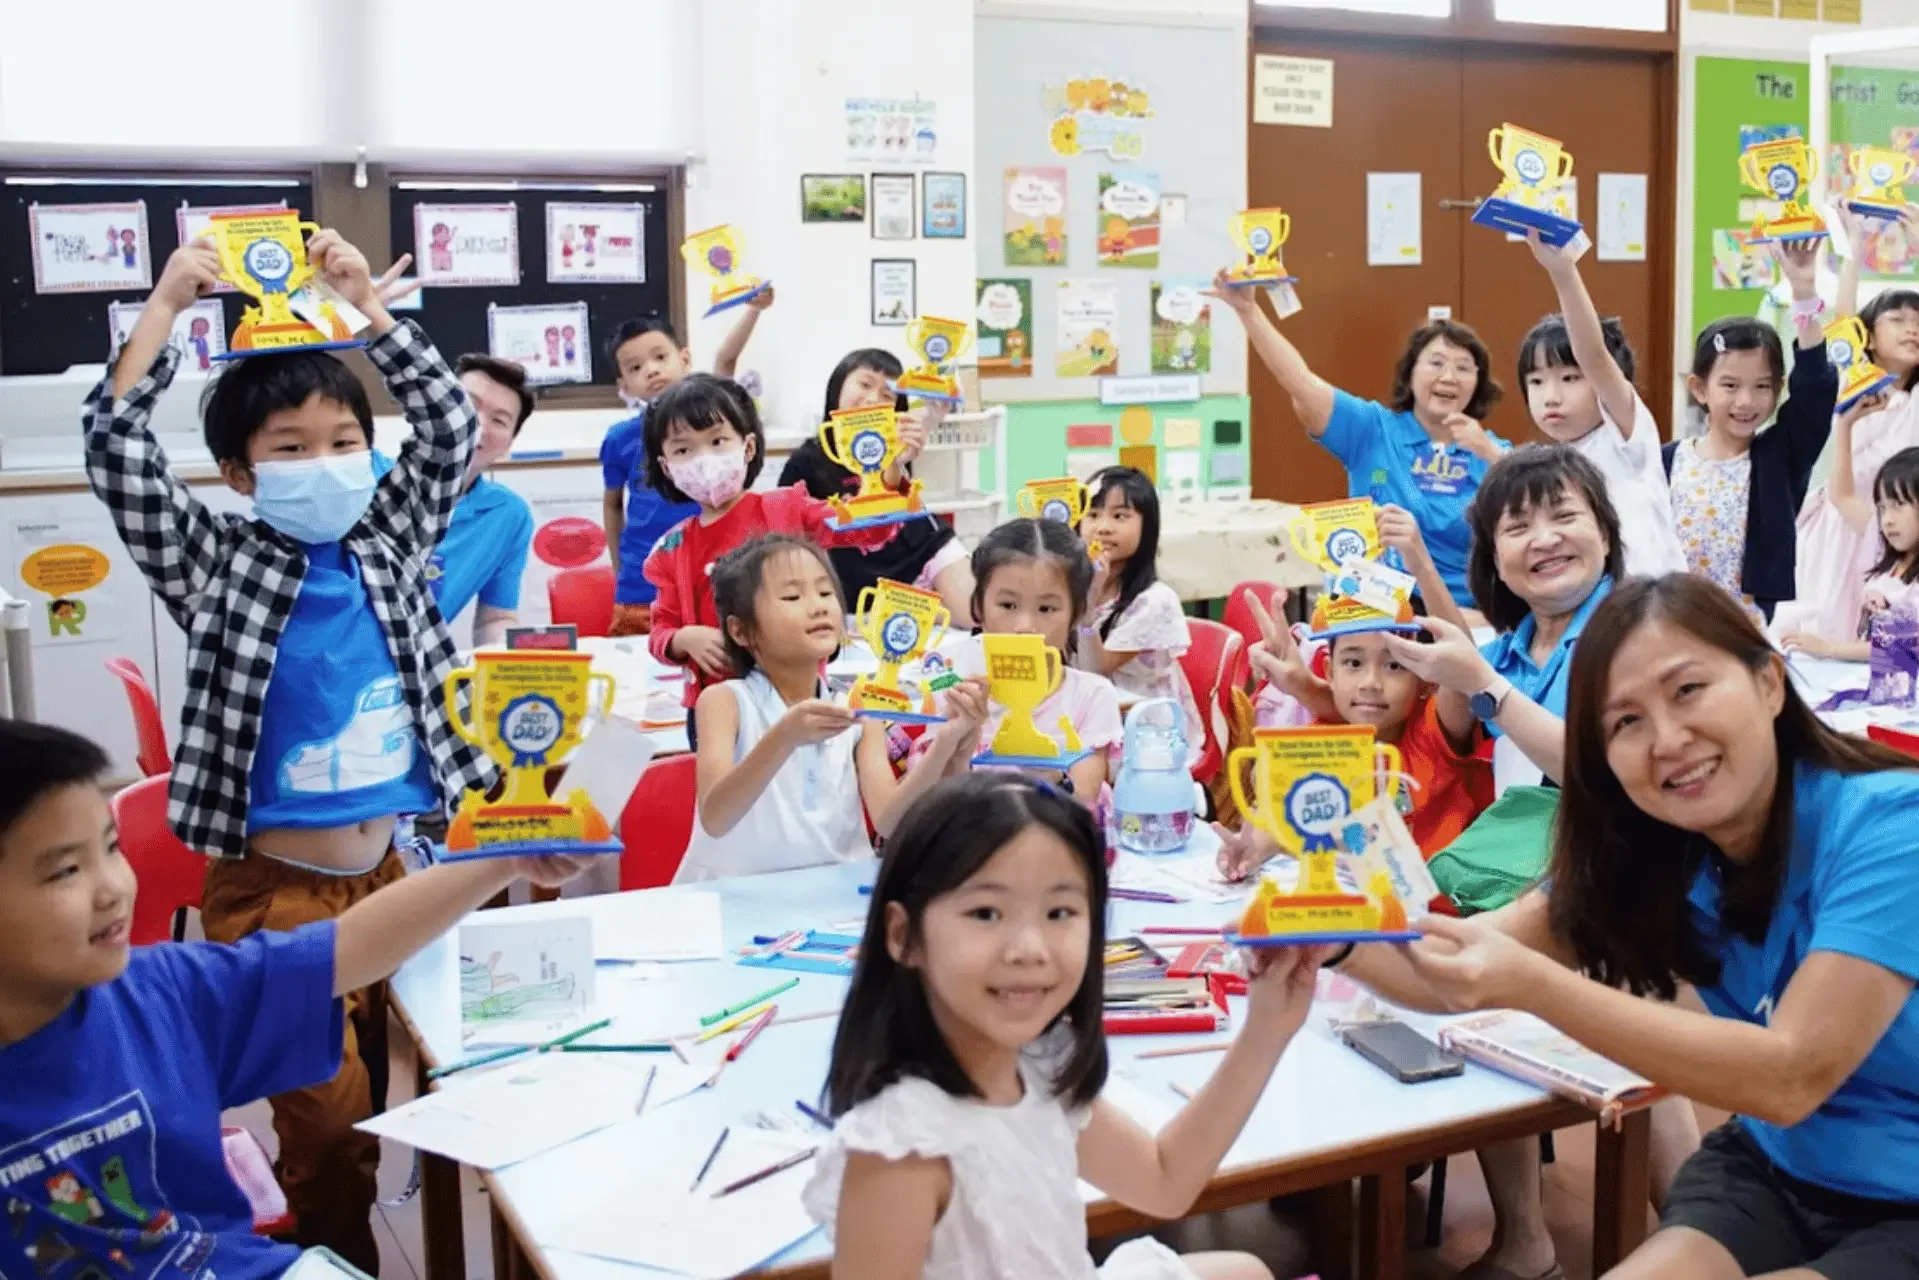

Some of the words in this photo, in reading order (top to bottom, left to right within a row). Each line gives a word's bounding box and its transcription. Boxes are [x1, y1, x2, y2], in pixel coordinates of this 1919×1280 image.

[1756, 74, 1794, 99] The
[1830, 83, 1877, 102] rtist
[520, 712, 548, 724] BEST
[512, 724, 552, 741] DAD!
[1304, 789, 1332, 805] BEST
[1302, 803, 1340, 824] DAD!
[45, 1109, 142, 1165] TOGETHER
